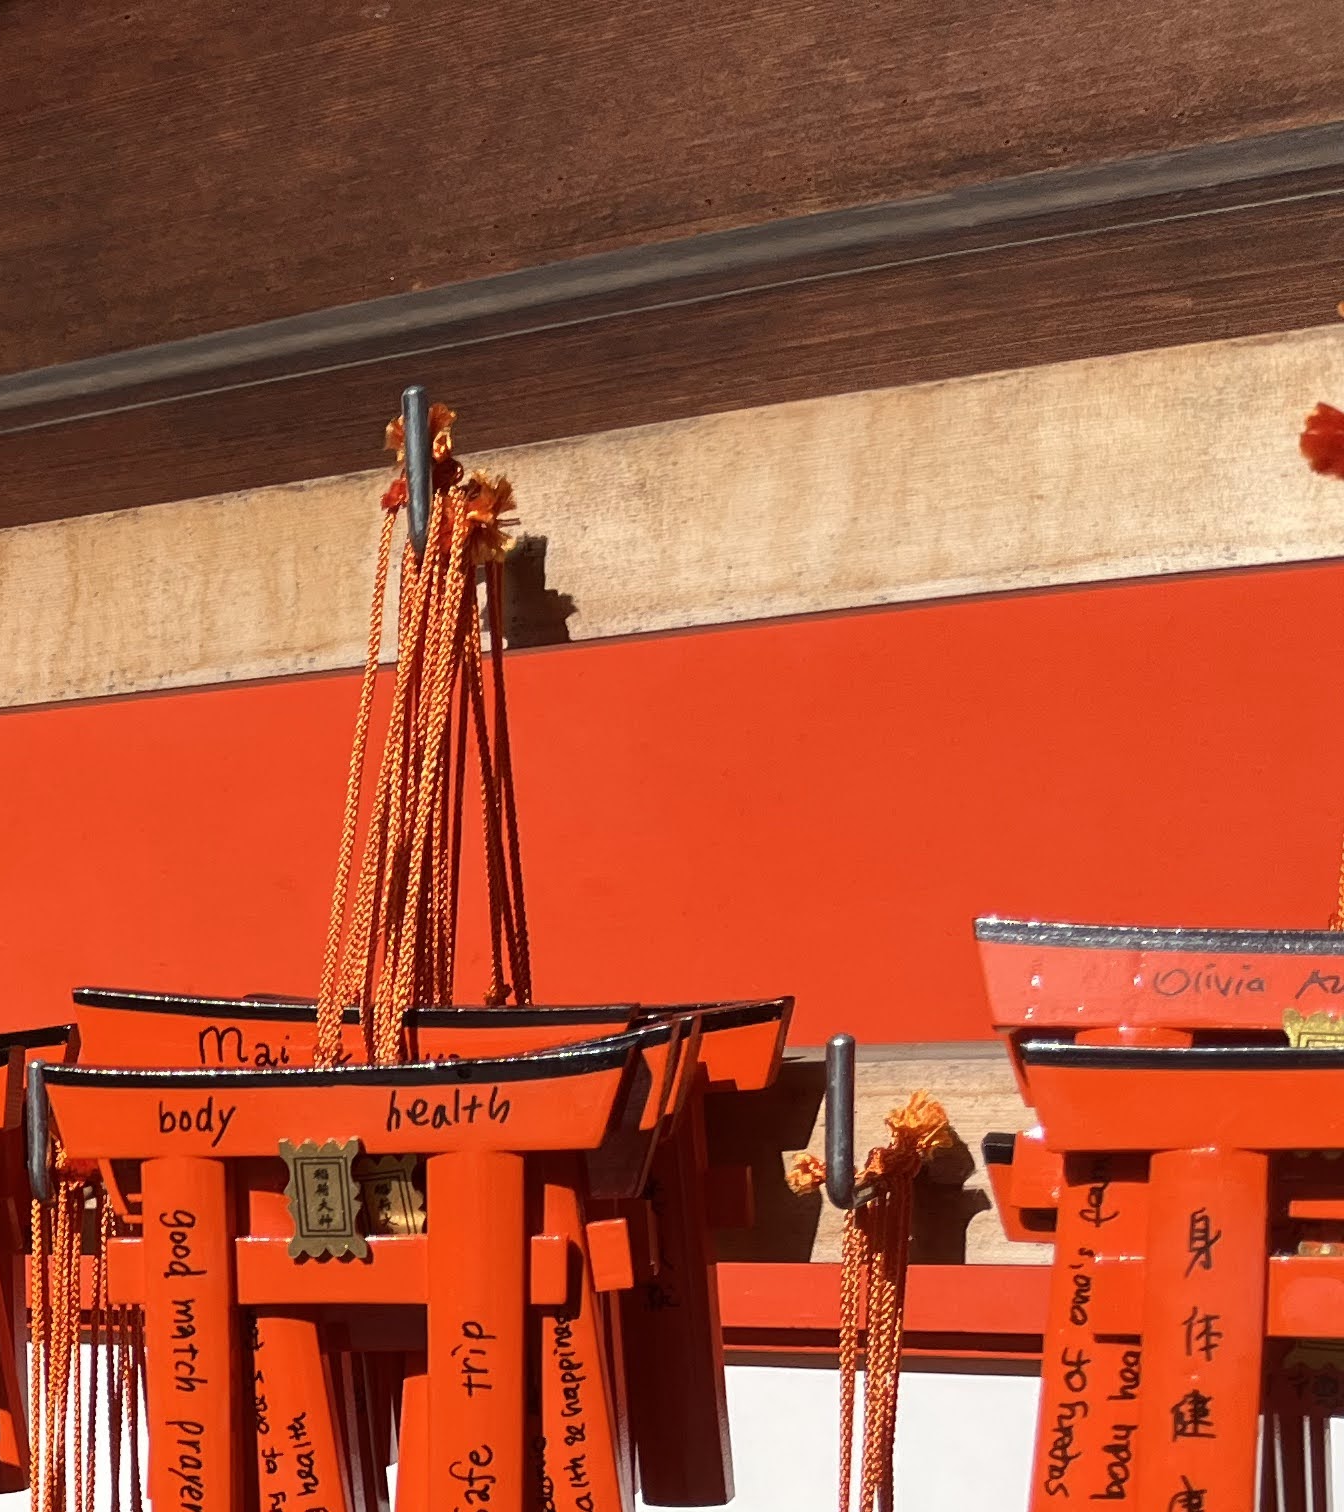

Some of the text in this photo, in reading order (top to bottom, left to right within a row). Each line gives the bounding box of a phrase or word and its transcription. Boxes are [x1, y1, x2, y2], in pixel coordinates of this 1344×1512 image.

[1153, 963, 1266, 997] Olivia
[157, 1093, 512, 1146] body health
[159, 1208, 206, 1279] good
[170, 1300, 208, 1394] match
[461, 1319, 500, 1398] trip
[1061, 1346, 1091, 1393] of
[286, 1411, 319, 1496] health
[1089, 1423, 1139, 1500] body
